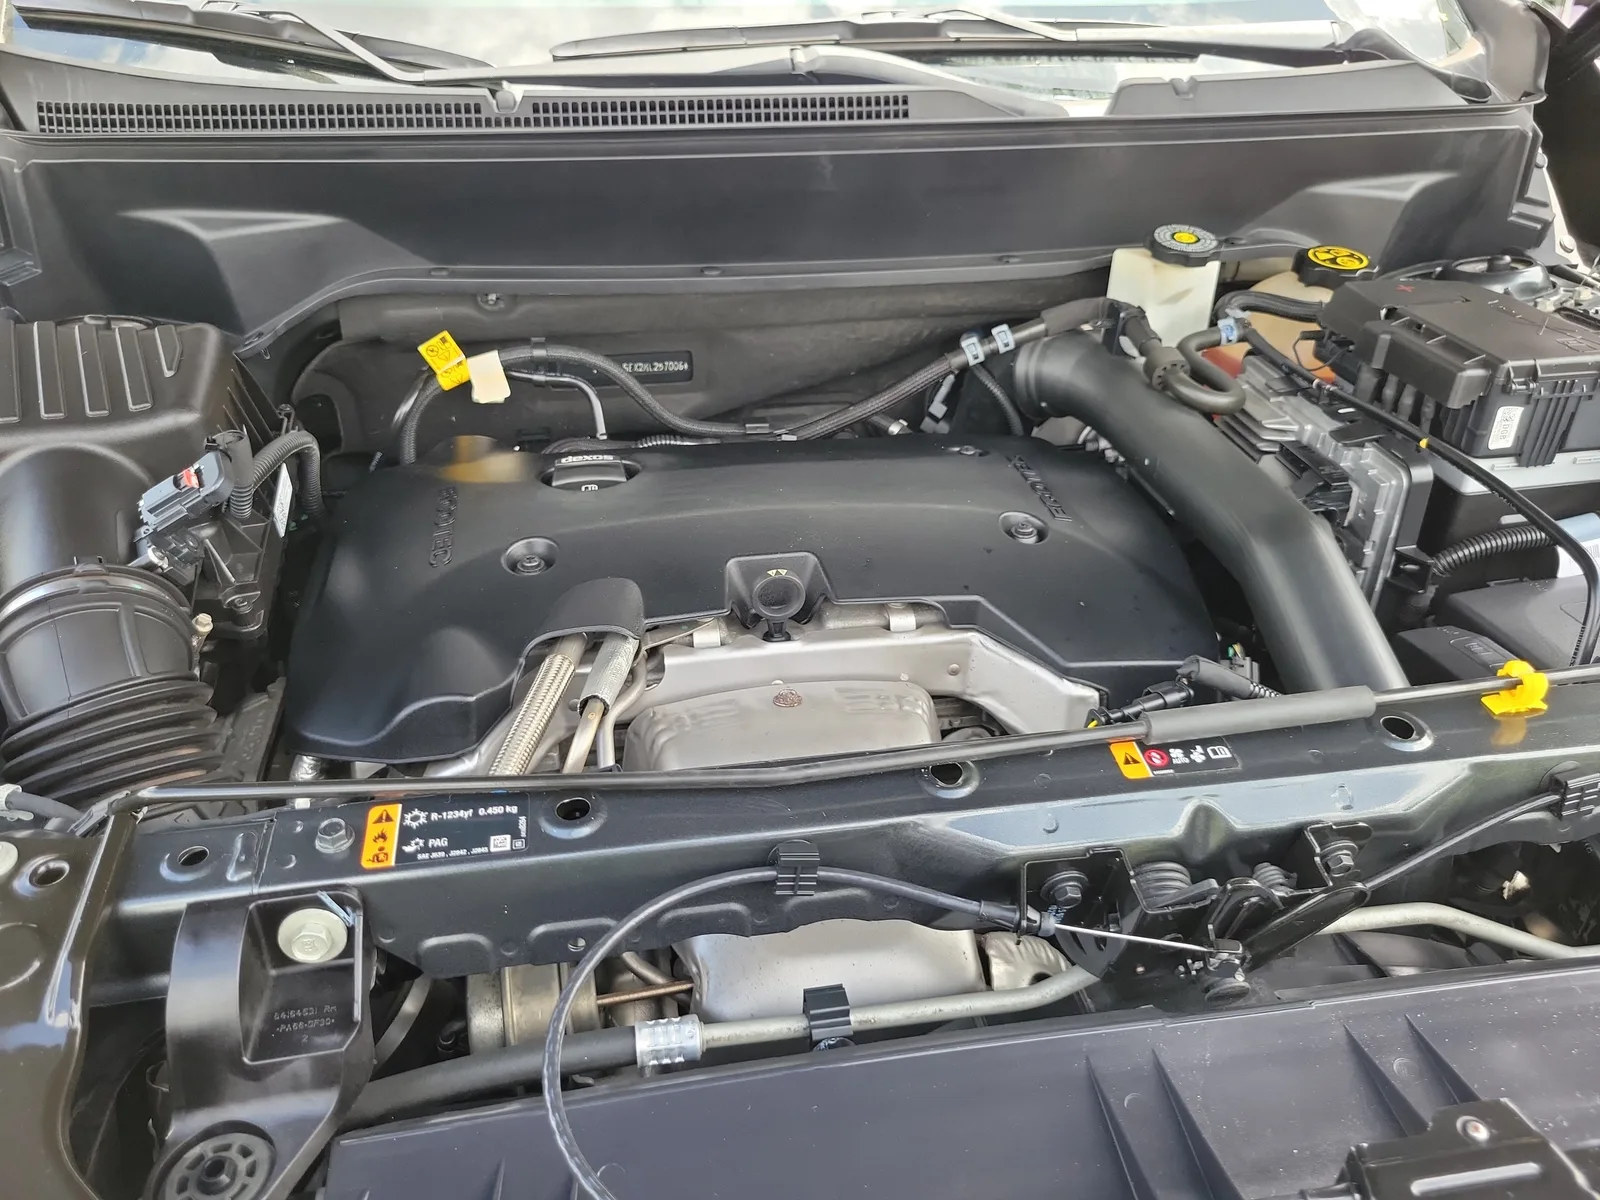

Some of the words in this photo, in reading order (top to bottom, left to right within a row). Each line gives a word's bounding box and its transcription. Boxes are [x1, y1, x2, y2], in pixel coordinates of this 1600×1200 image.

[561, 455, 614, 464] dexos
[430, 809, 473, 820] R-1234yf
[478, 806, 504, 816] 0.450
[505, 805, 518, 814] kg
[428, 838, 449, 848] PAG
